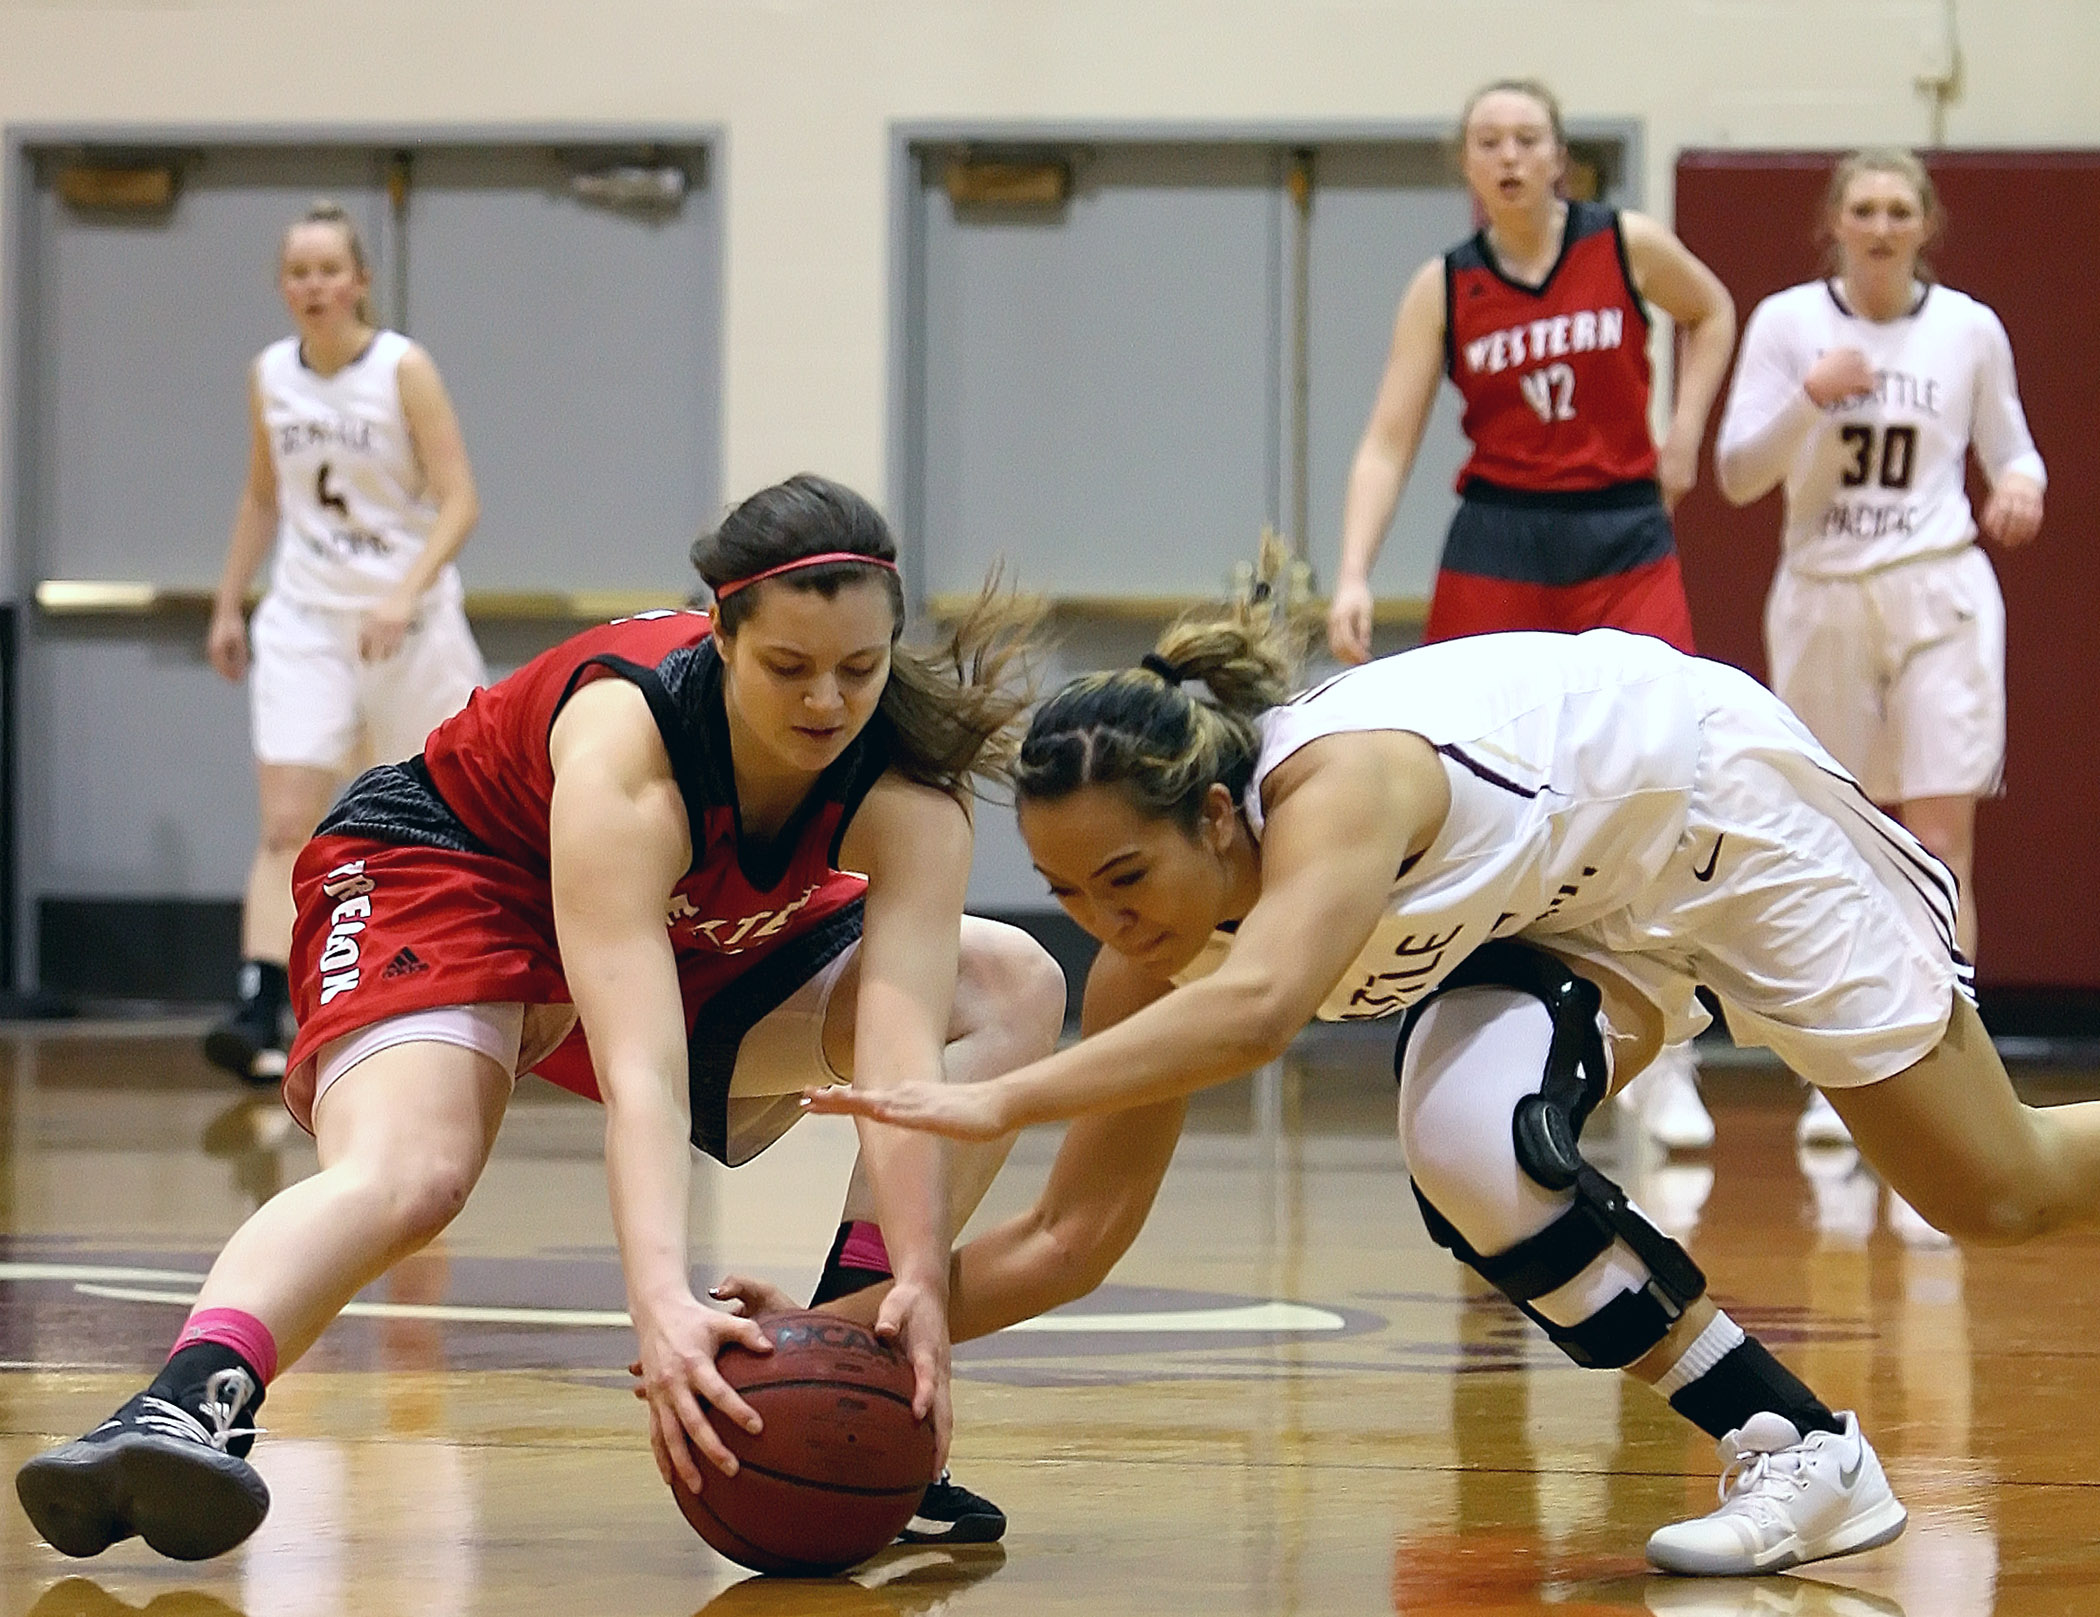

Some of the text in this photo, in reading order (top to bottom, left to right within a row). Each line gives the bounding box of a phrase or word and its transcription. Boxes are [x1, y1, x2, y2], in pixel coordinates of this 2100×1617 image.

[1465, 307, 1623, 374] WESTERN
[1826, 368, 1940, 418] TTLE
[1841, 422, 1917, 488] 30
[1340, 923, 1464, 1019] TTLE
